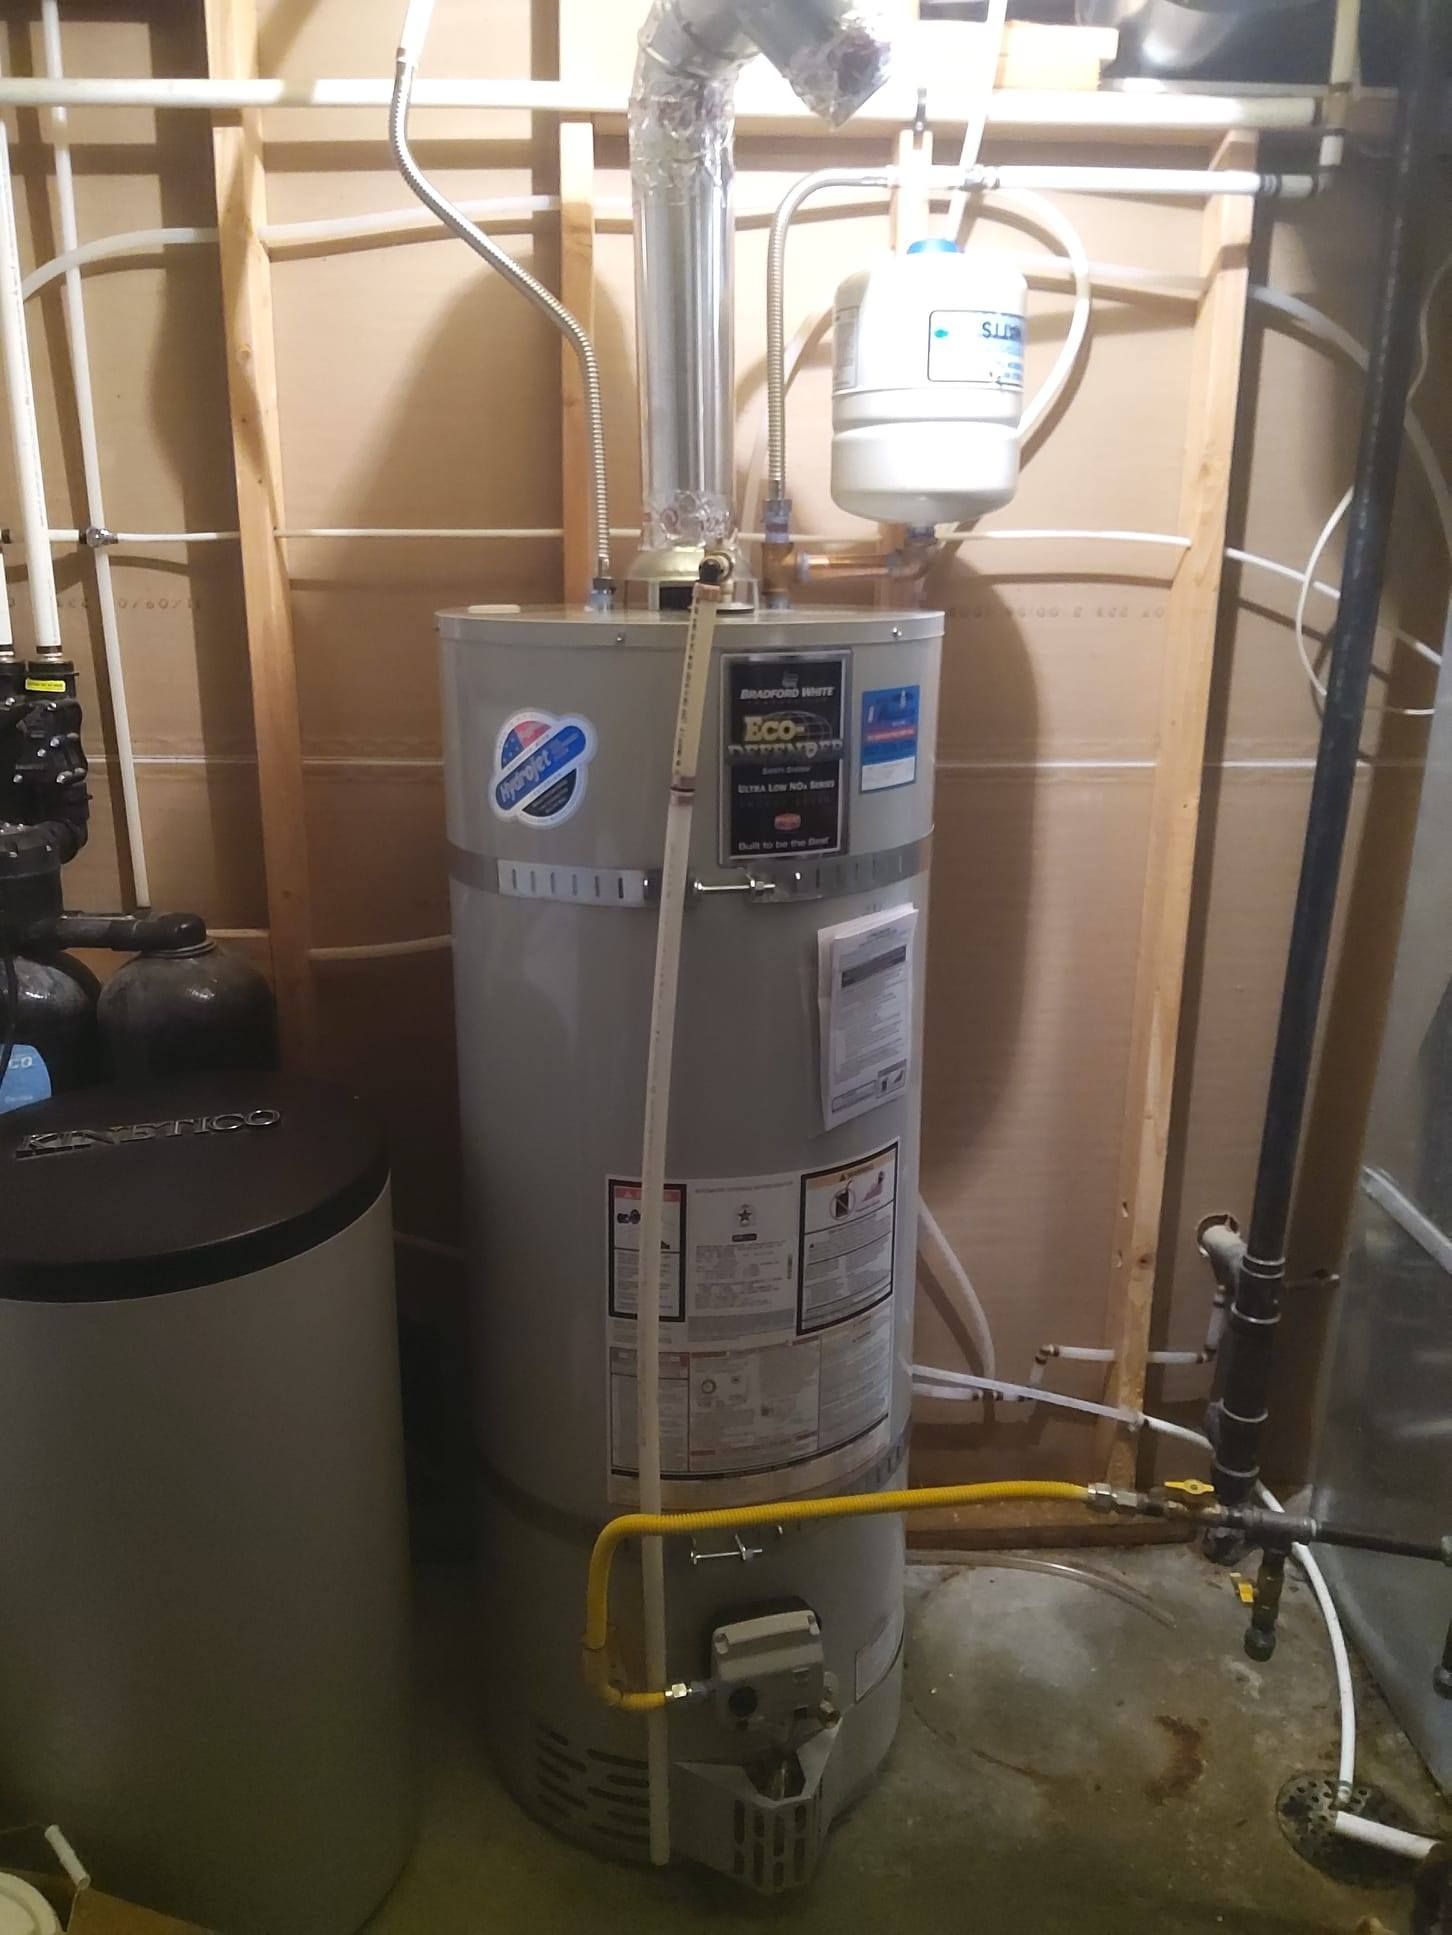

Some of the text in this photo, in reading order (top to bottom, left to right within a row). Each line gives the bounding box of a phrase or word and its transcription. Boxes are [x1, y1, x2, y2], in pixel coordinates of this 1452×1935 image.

[740, 686, 835, 700] BRADFORD WHITE
[738, 784, 766, 794] ULTRA
[768, 783, 787, 792] LOW
